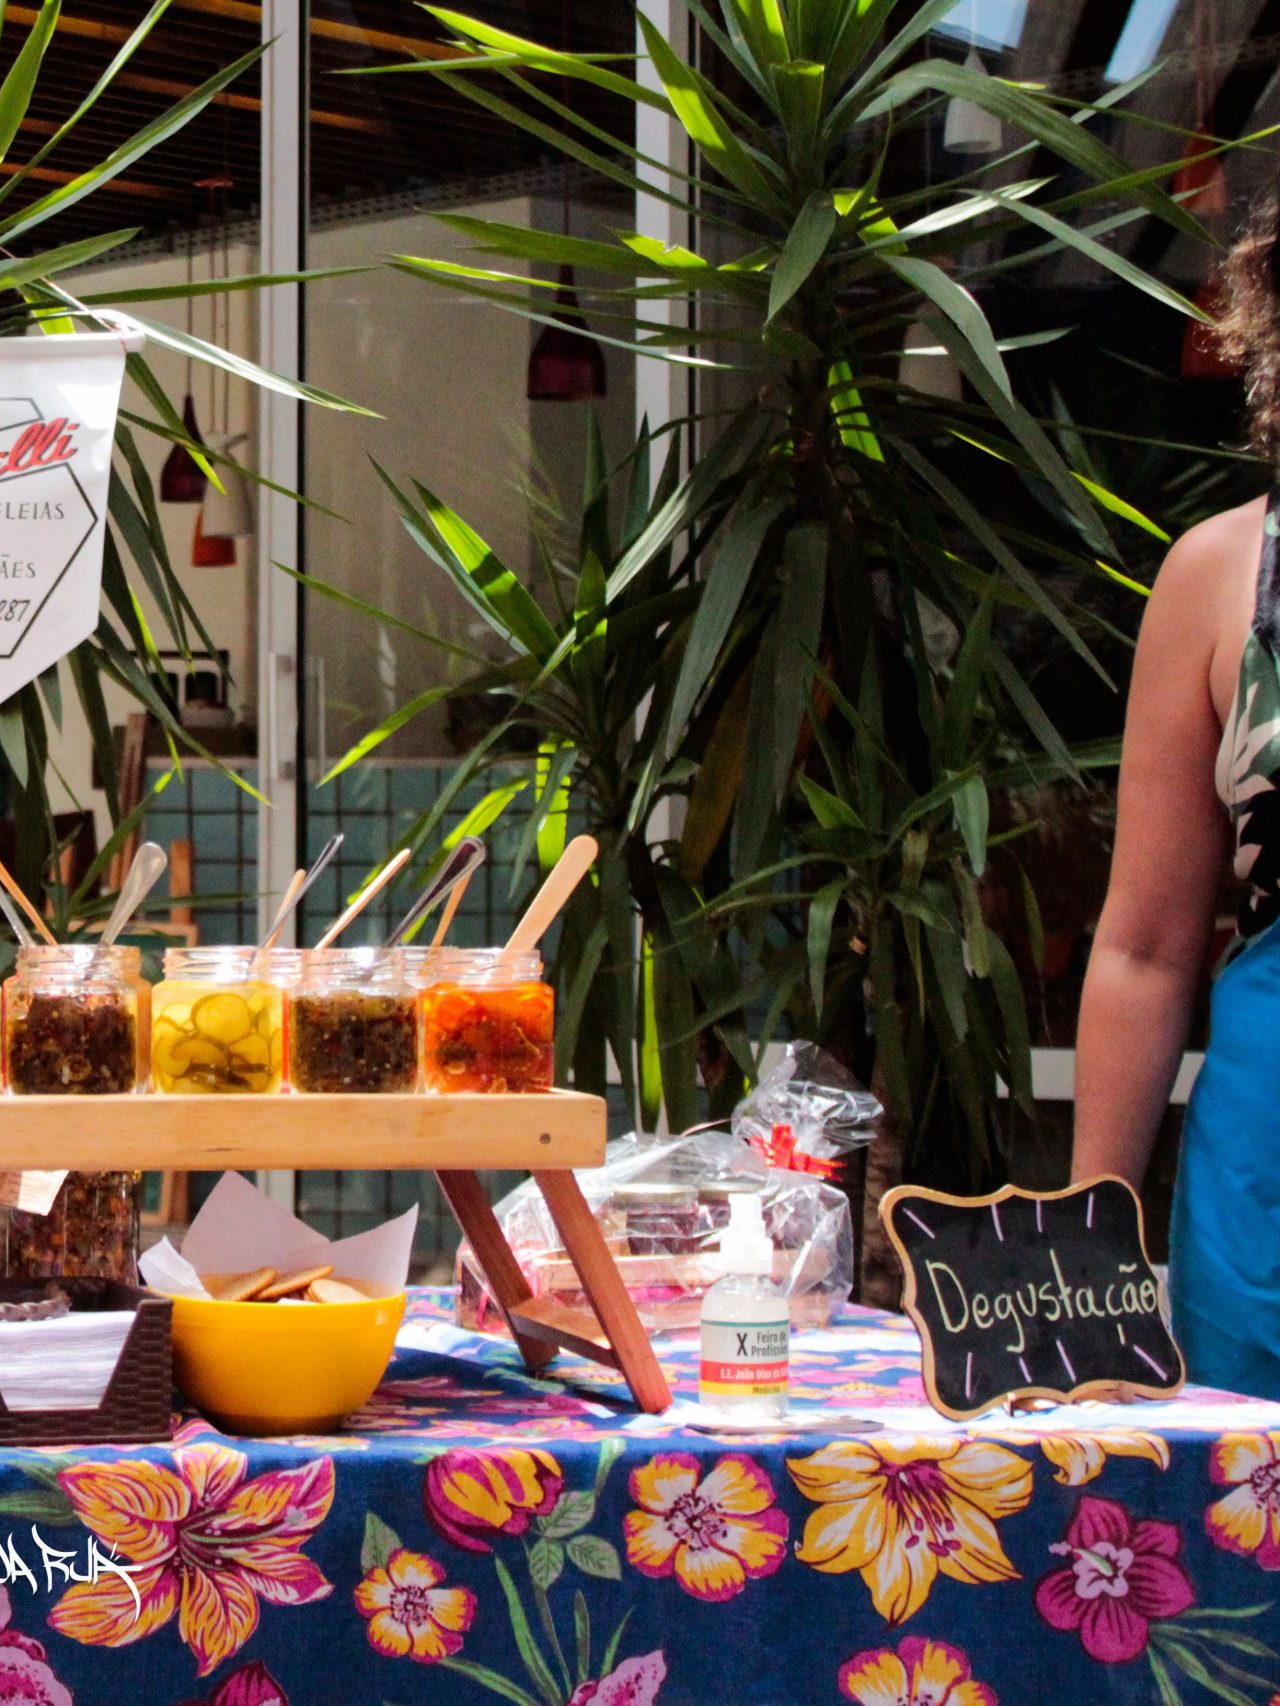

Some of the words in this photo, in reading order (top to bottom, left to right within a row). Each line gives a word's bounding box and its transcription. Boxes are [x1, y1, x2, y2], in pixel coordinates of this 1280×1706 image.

[925, 1248, 1158, 1354] Degustação
[736, 1332, 748, 1357] X
[756, 1331, 778, 1344] Feira
